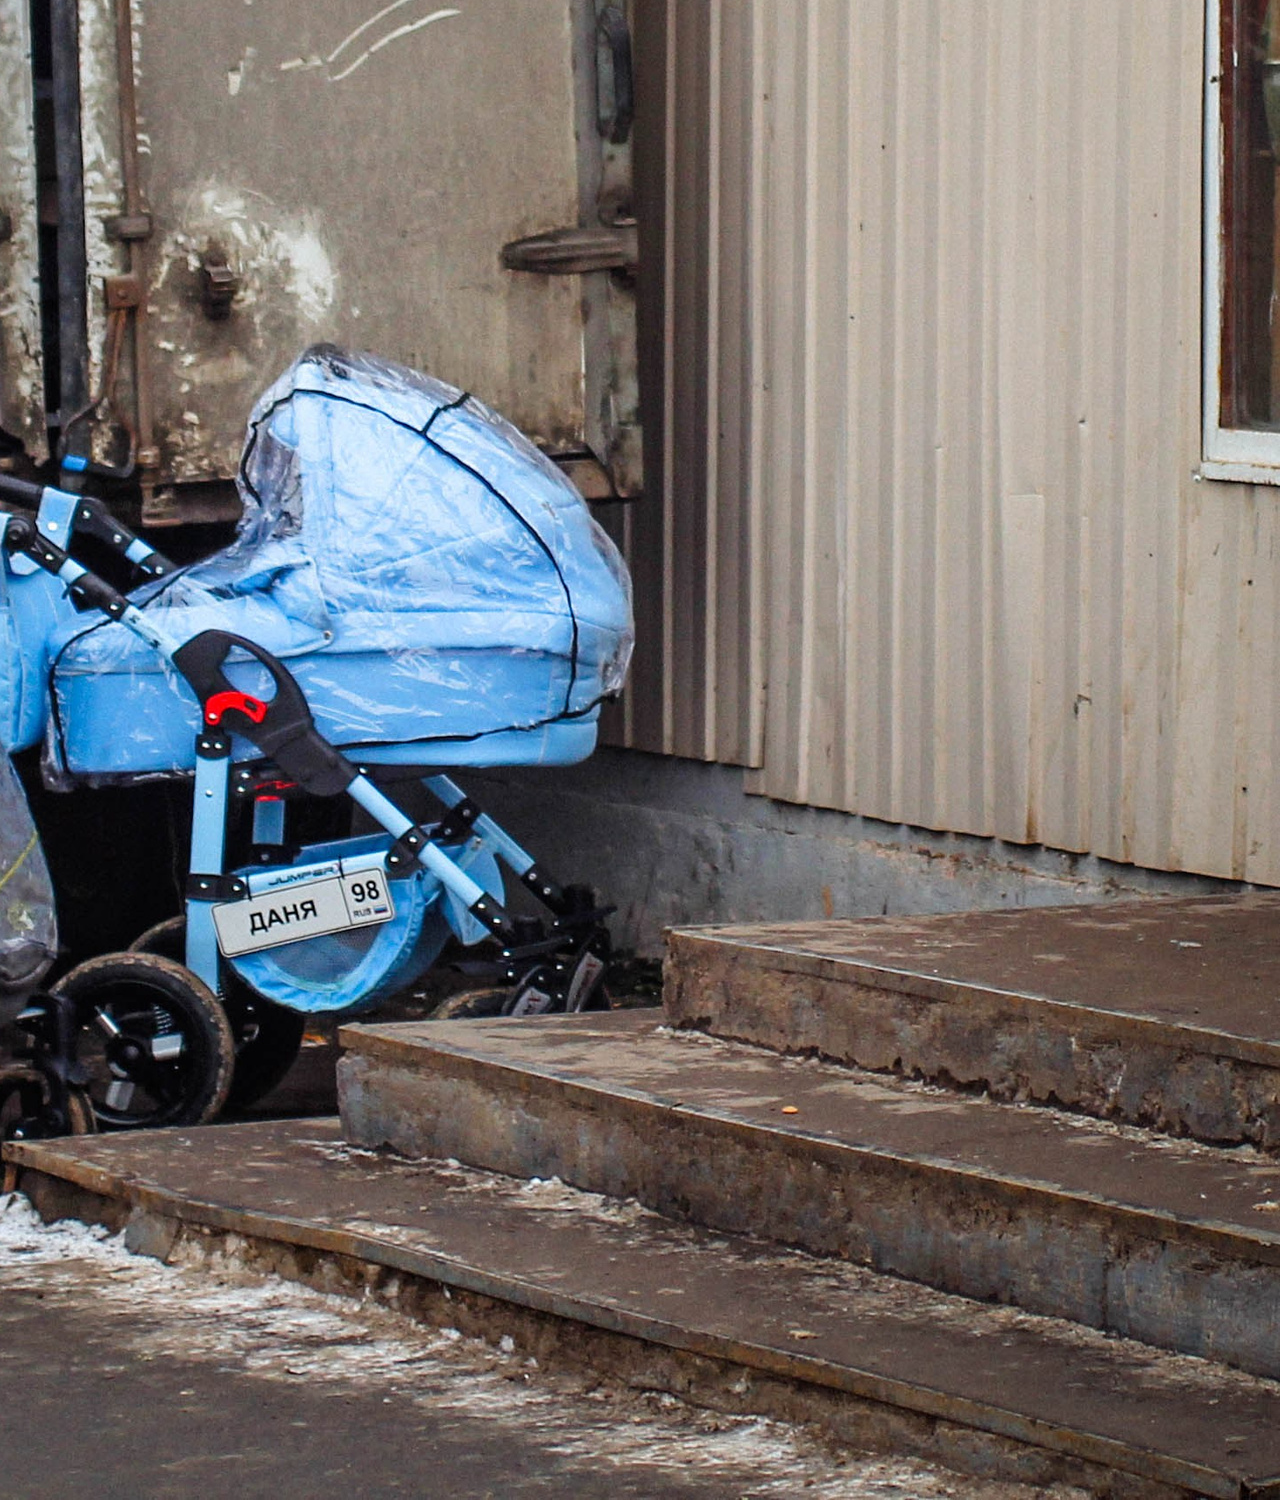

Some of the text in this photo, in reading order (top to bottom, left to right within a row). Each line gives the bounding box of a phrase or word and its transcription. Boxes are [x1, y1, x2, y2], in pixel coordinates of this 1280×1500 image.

[268, 866, 334, 886] JUMPER
[351, 880, 380, 903] 98
[249, 900, 318, 935] ДАНЯ
[353, 907, 371, 918] RUS
